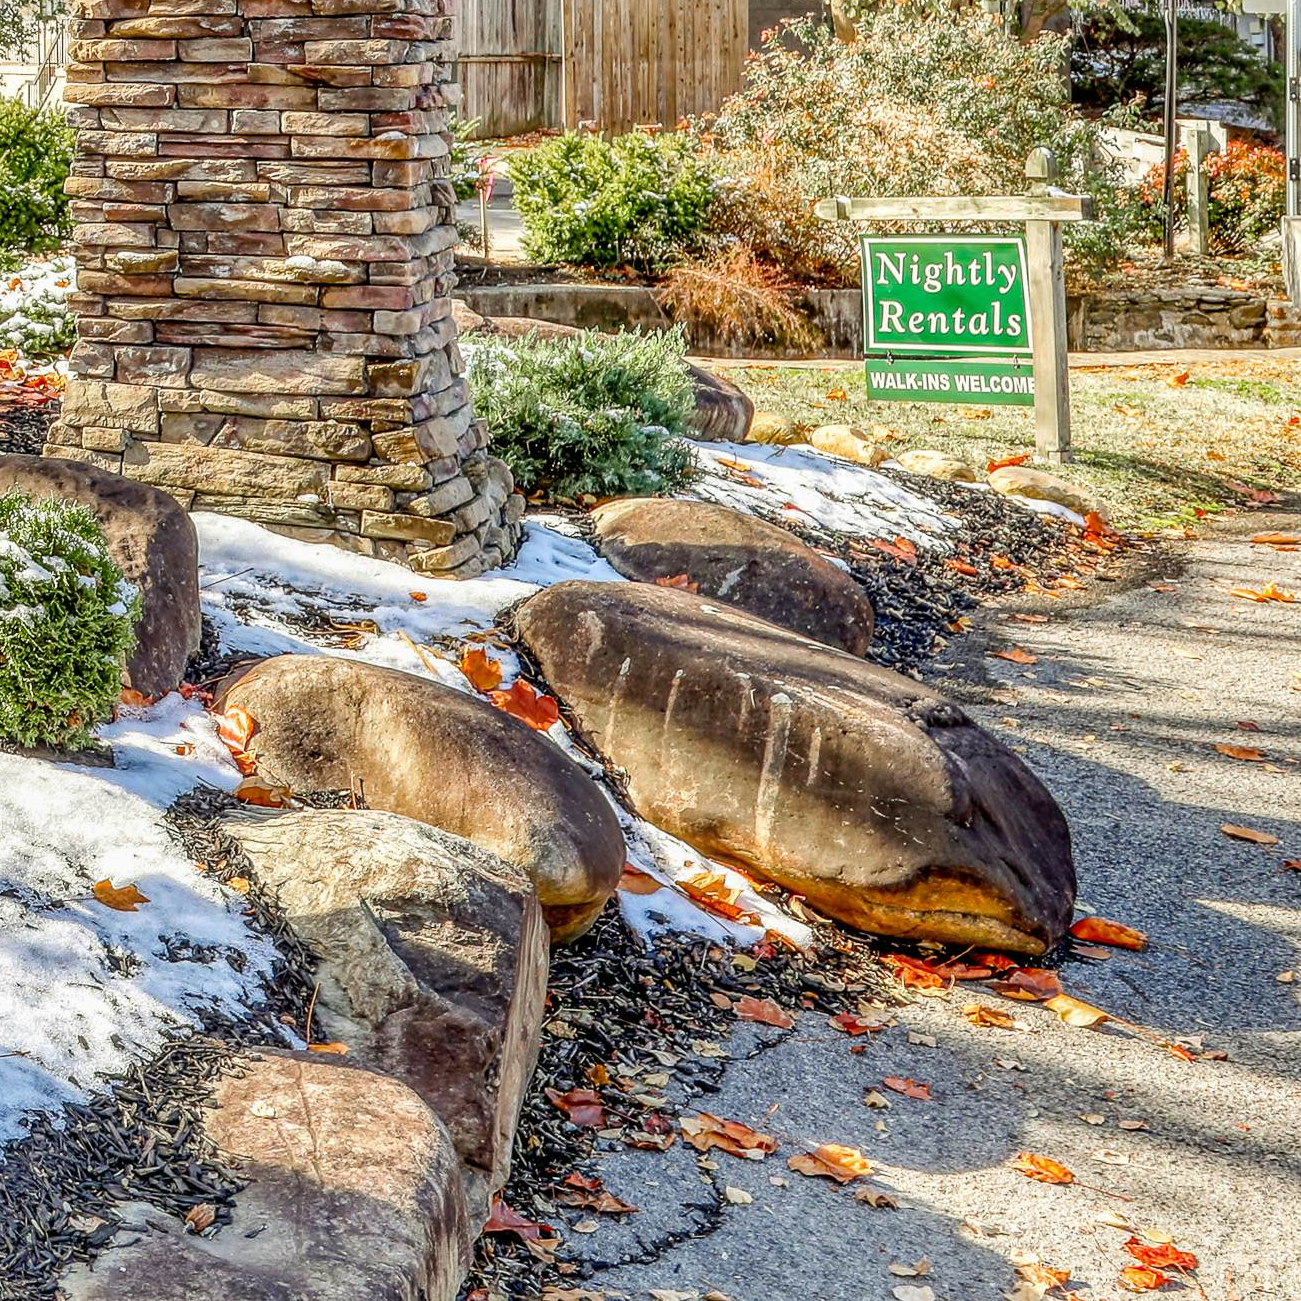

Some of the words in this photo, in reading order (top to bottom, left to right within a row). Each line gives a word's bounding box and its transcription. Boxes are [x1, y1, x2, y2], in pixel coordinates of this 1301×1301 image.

[875, 252, 1017, 294] Nightly
[878, 299, 1022, 336] Rentals
[870, 371, 950, 391] WALK-INS
[954, 374, 1035, 395] WELCOME
